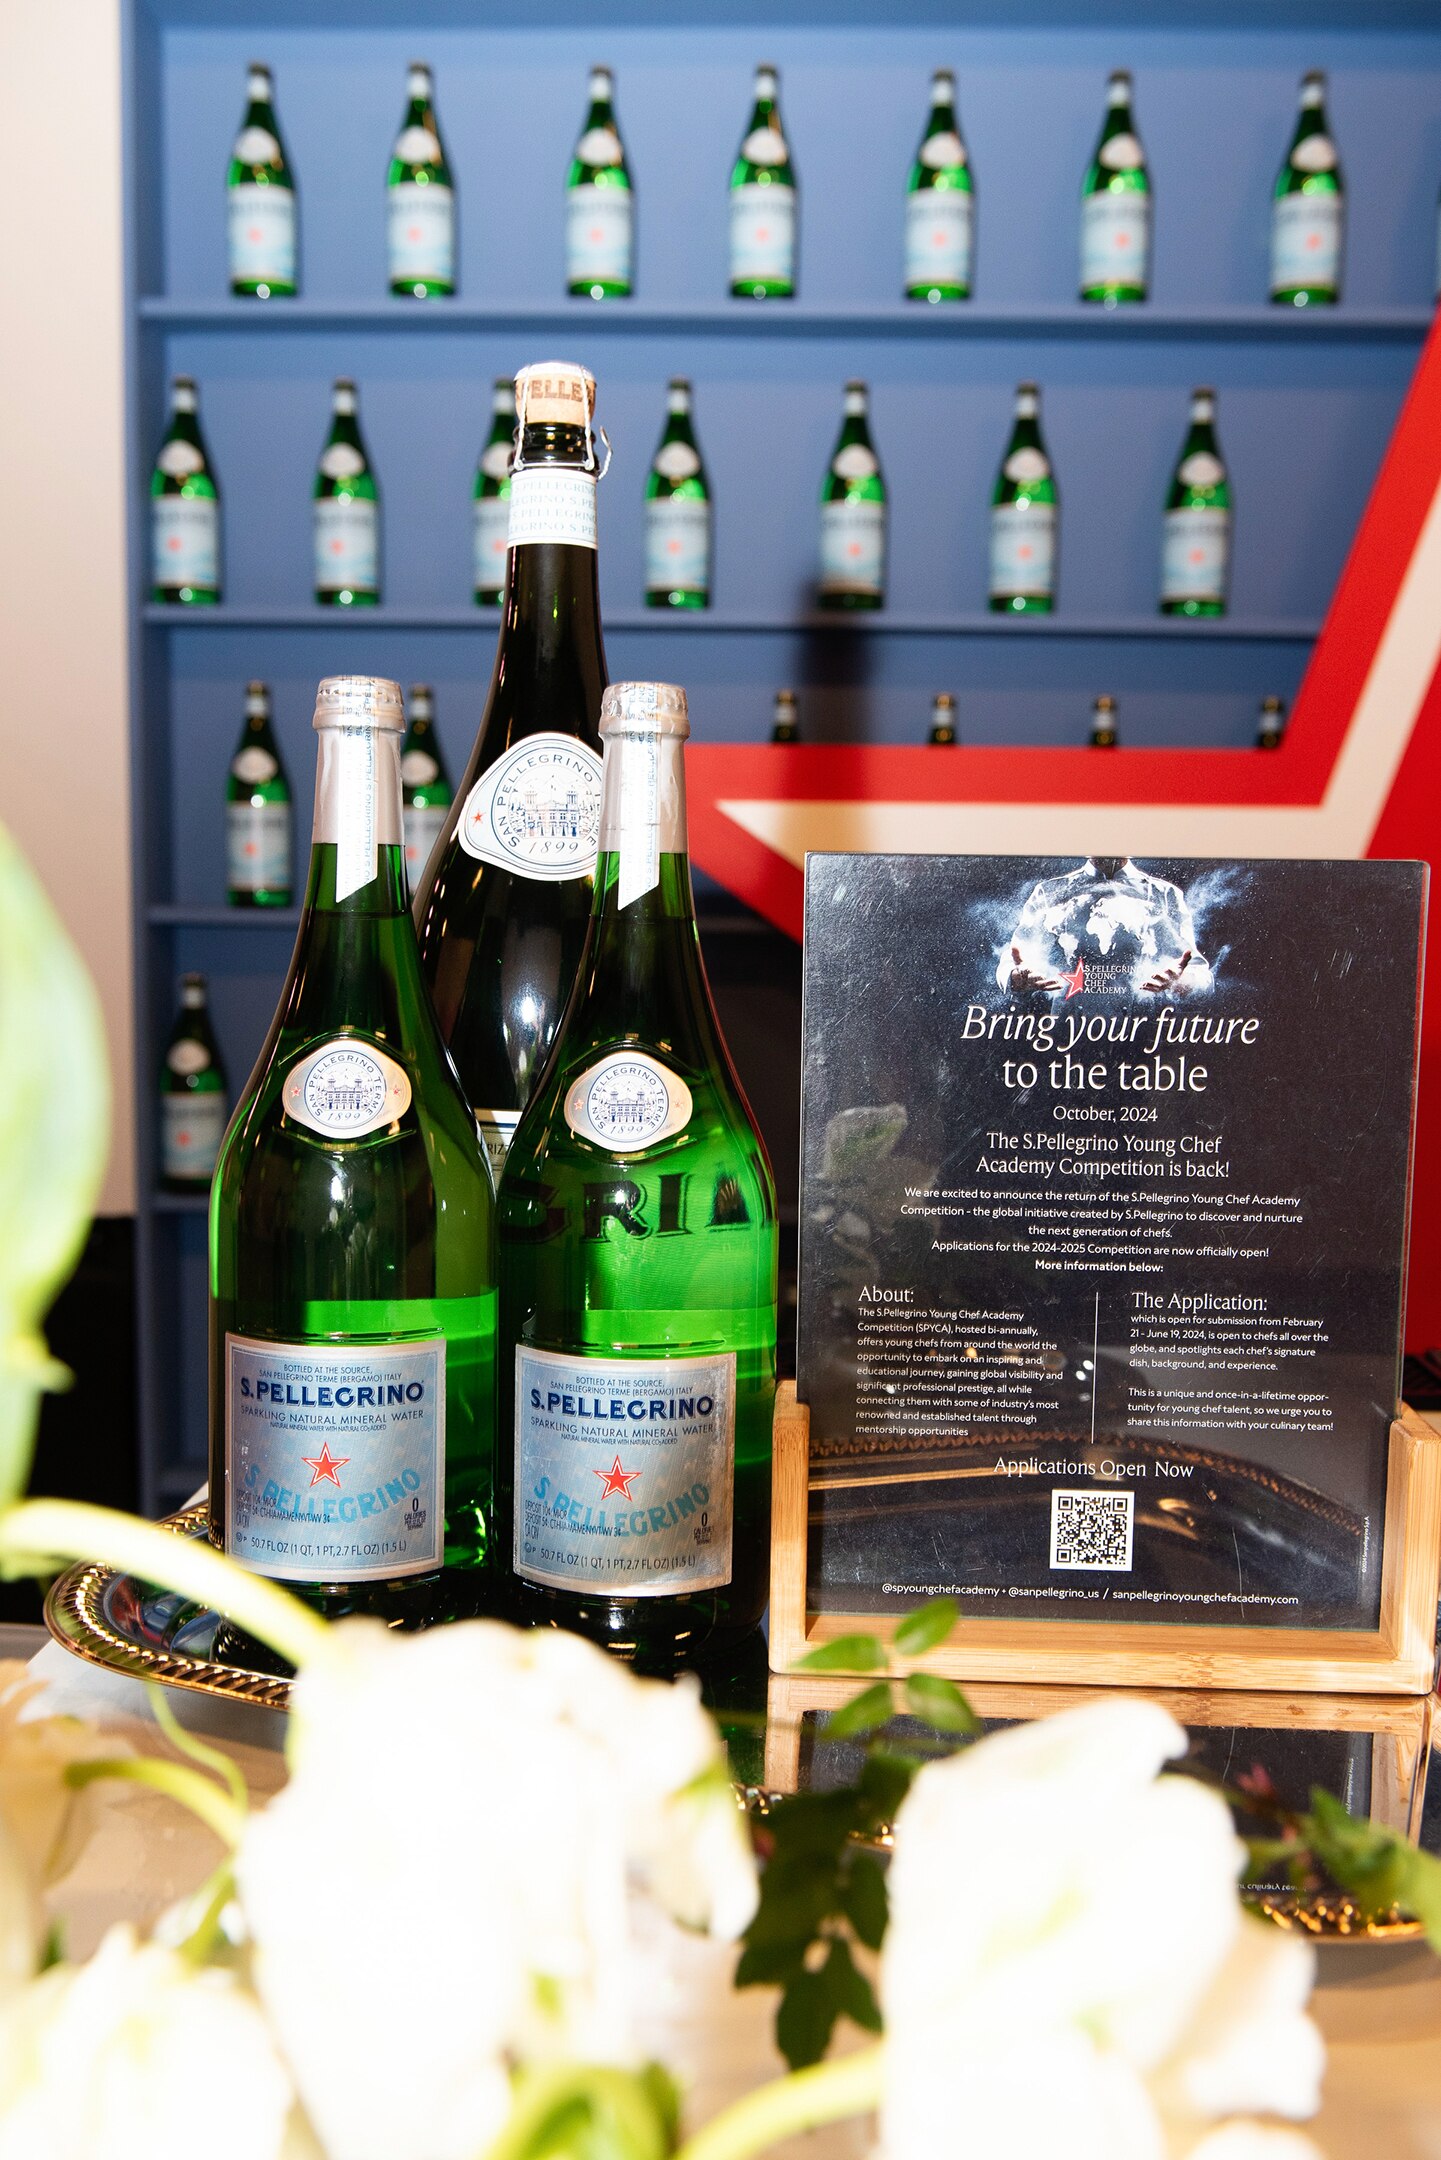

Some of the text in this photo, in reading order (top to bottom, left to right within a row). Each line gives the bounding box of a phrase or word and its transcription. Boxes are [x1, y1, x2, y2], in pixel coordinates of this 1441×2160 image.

[497, 754, 593, 848] SAN PELLEGRINO
[528, 841, 579, 854] 1899
[1085, 972, 1116, 980] YOUNG
[960, 1005, 1260, 1053] Bring your future
[1002, 1053, 1208, 1091] to the table
[309, 1054, 382, 1117] SAN PELLEGRINO TERME
[591, 1067, 664, 1130] SAN PELLEGRINO TERME
[327, 1112, 361, 1121] 1899
[1052, 1105, 1158, 1122] October, 2024
[610, 1125, 644, 1134] 1899
[986, 1132, 1223, 1155] The S.Pellegrino Young Chef
[975, 1154, 1229, 1179] Academy Competition is back!
[903, 1186, 1301, 1207] We are excited to announce the return of the S.Pellegrino Young Chef Academy
[900, 1204, 1303, 1223] Competition the global initiative created by S.Pellegrino to discover and nurture
[1027, 1224, 1173, 1238] the next generation of chefs.
[930, 1240, 1269, 1259] Applications for the 2024-2025 Competition are now officially open!
[1034, 1259, 1164, 1272] More information below:
[857, 1285, 915, 1303] About:
[1131, 1291, 1268, 1313] The Application:
[857, 1307, 1025, 1322] The S.Pellegrino Young Chef Academy
[1130, 1313, 1324, 1329] which is open for submission from February
[1129, 1328, 1329, 1342] 21 June 19, 2024, is open to chefs all over the
[259, 1369, 402, 1384] SAN PELLEGRINO TERME (BERGAMO) ITALY
[284, 1364, 373, 1375] BOTTLED AT THE SOURCE,
[240, 1377, 425, 1408] S.PELLEGRINO
[550, 1381, 694, 1398] SAN PELLEGRINO TERME (BERGAMO) ITALY
[530, 1388, 715, 1422] S.PELLEGRINO
[240, 1405, 424, 1425] SPARKLING NATURAL MINERAL WATER
[530, 1416, 715, 1438] SPARKLING NATURAL MINERAL WATER
[992, 1457, 1194, 1481] Applications Open Now
[881, 1582, 1299, 1605] @spyoungchefacademy @sanpellegrino_us sanpellegrinoyoungchefacademy.com
